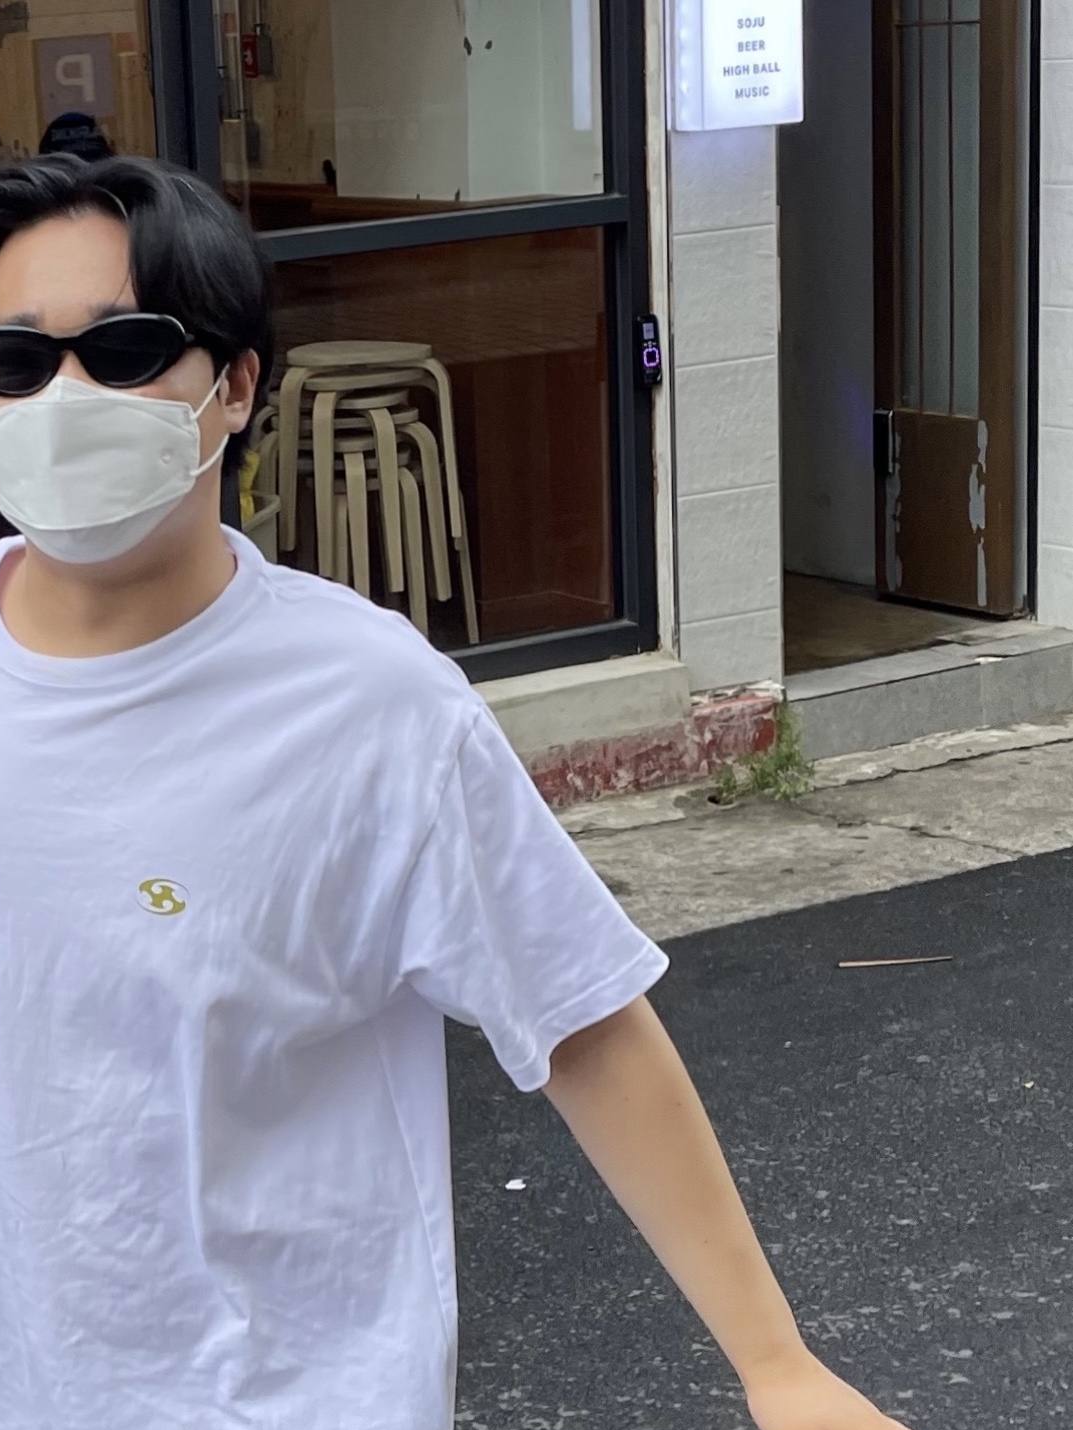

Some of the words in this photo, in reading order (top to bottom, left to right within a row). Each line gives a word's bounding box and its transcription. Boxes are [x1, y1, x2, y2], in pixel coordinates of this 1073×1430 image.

[737, 16, 765, 29] SOJU
[737, 40, 765, 52] BEER
[723, 65, 749, 77] HIGH
[753, 62, 781, 74] BALL
[735, 86, 769, 99] MUSIC
